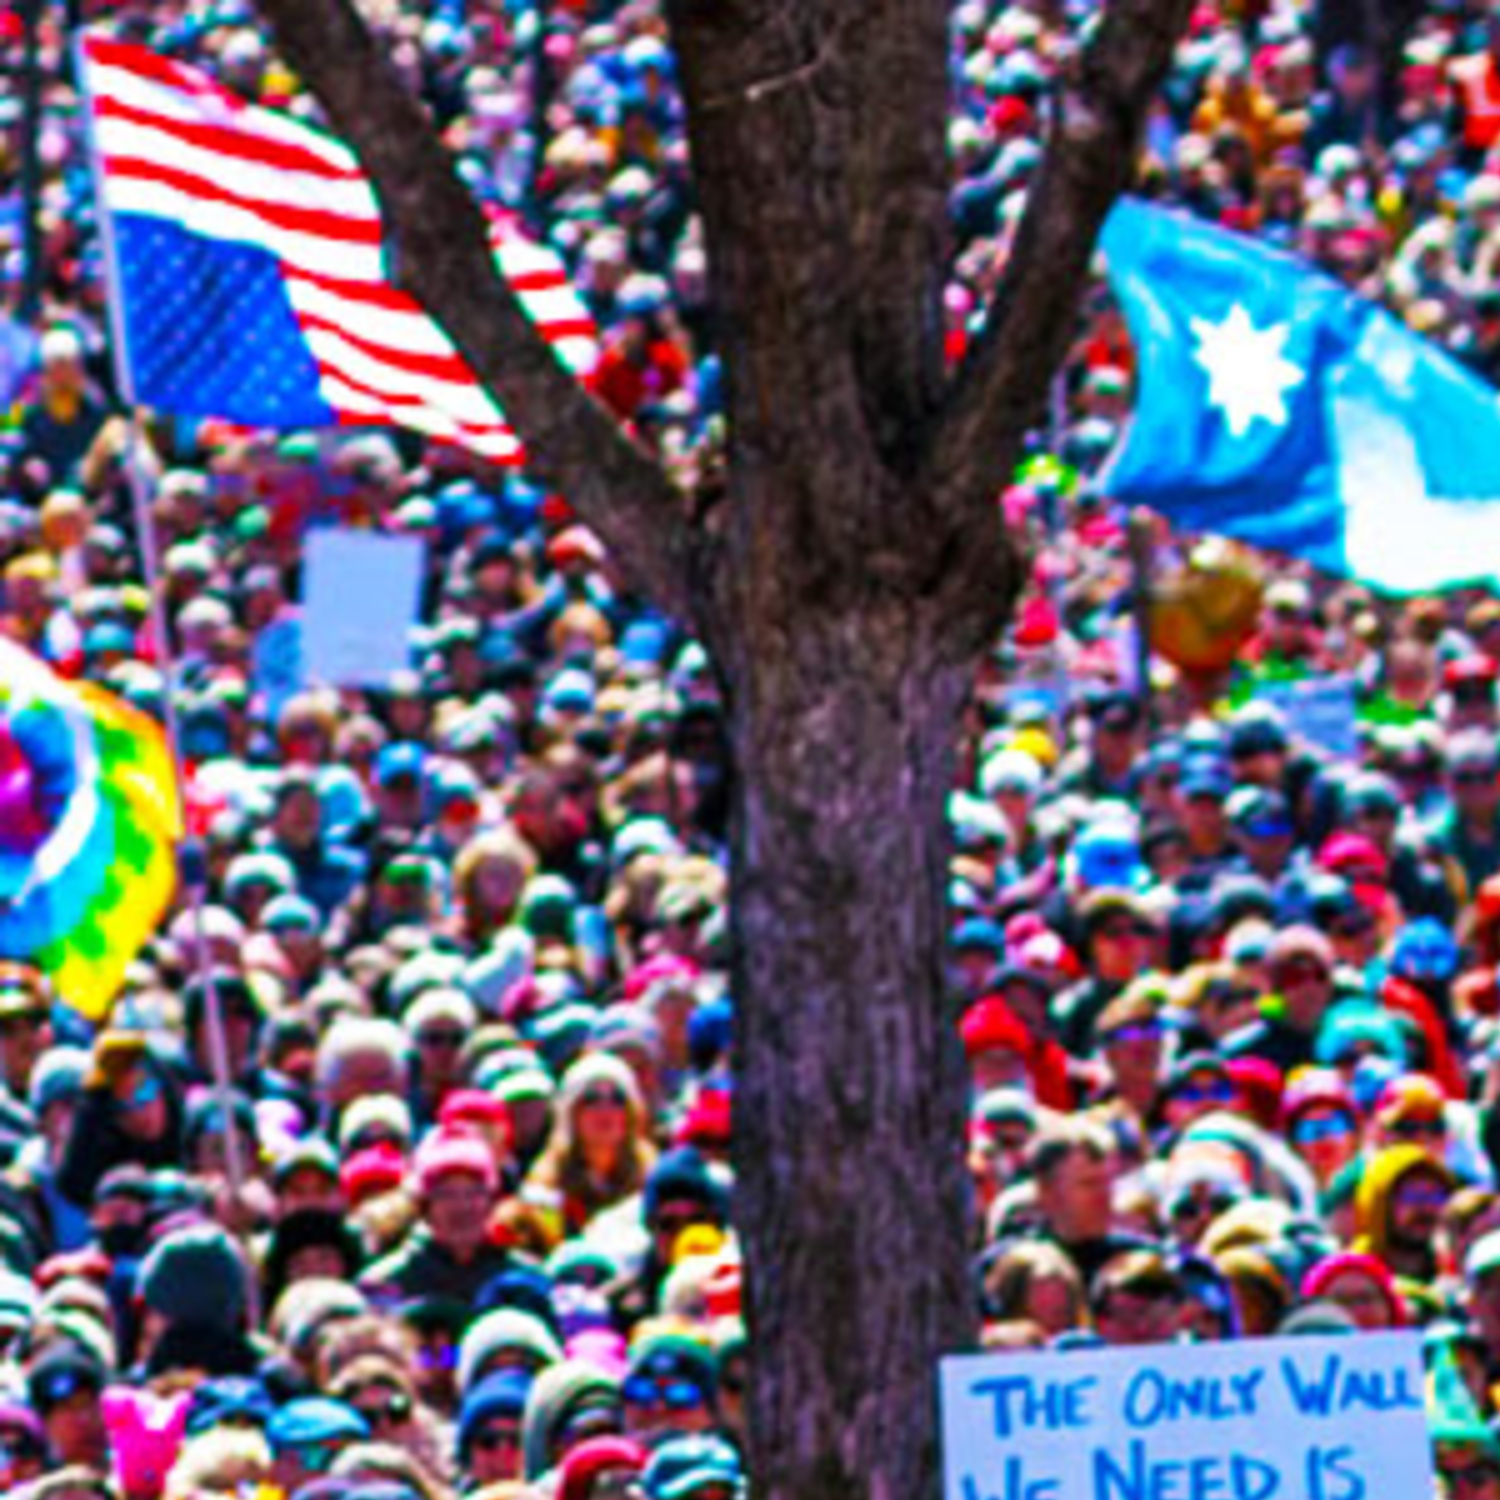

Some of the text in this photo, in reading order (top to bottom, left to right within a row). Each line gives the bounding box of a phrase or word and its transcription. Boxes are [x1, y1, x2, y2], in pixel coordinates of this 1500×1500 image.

[969, 1354, 1424, 1438] THE ONLY WALL
